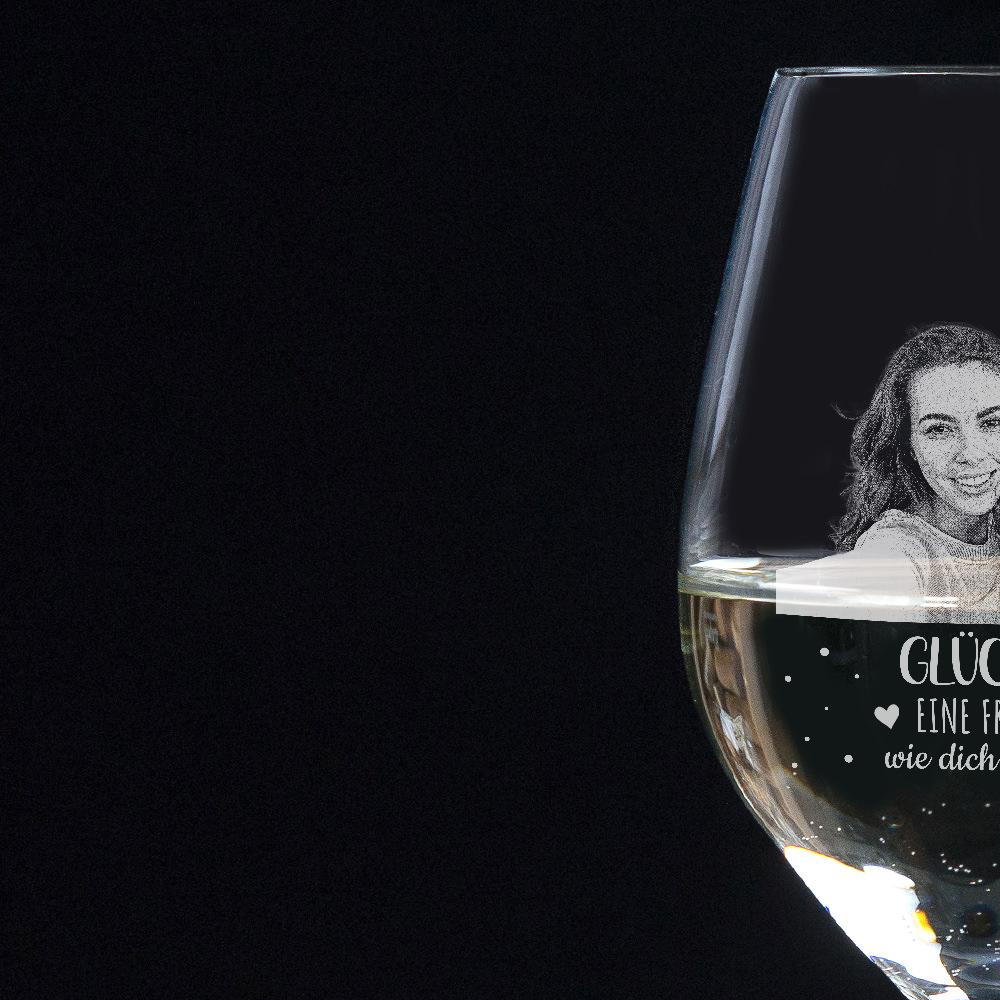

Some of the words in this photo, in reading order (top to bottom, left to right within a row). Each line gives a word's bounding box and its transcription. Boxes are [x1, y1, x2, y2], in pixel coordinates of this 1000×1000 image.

[916, 697, 970, 735] EINE
[884, 745, 933, 770] wie
[938, 743, 1000, 771] dich
